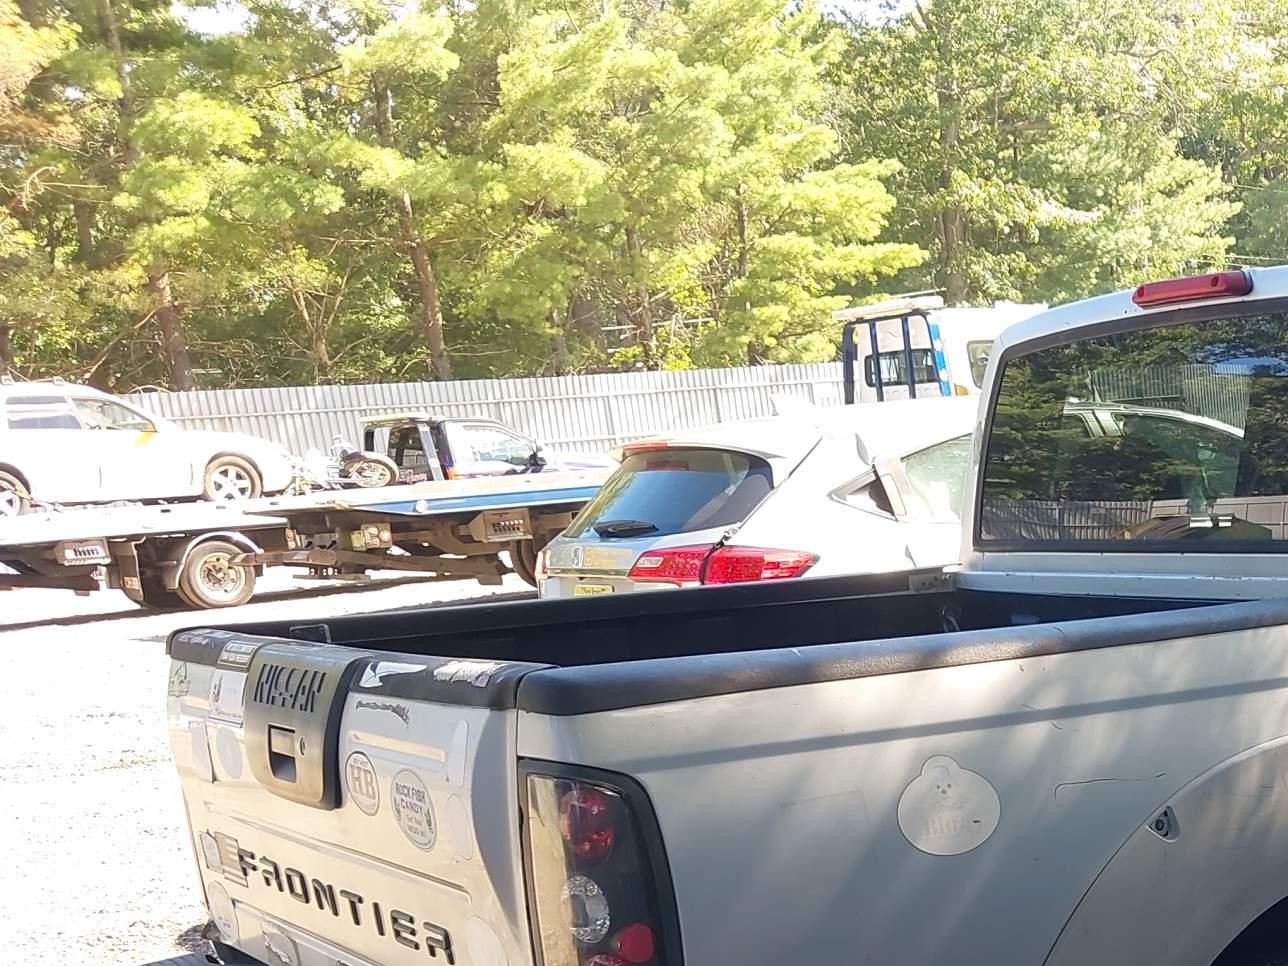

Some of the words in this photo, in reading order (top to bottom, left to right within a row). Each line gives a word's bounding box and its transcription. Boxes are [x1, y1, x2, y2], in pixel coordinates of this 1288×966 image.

[253, 663, 327, 712] NISSAN
[400, 798, 424, 816] CANDY
[237, 847, 456, 966] FRONTIER
